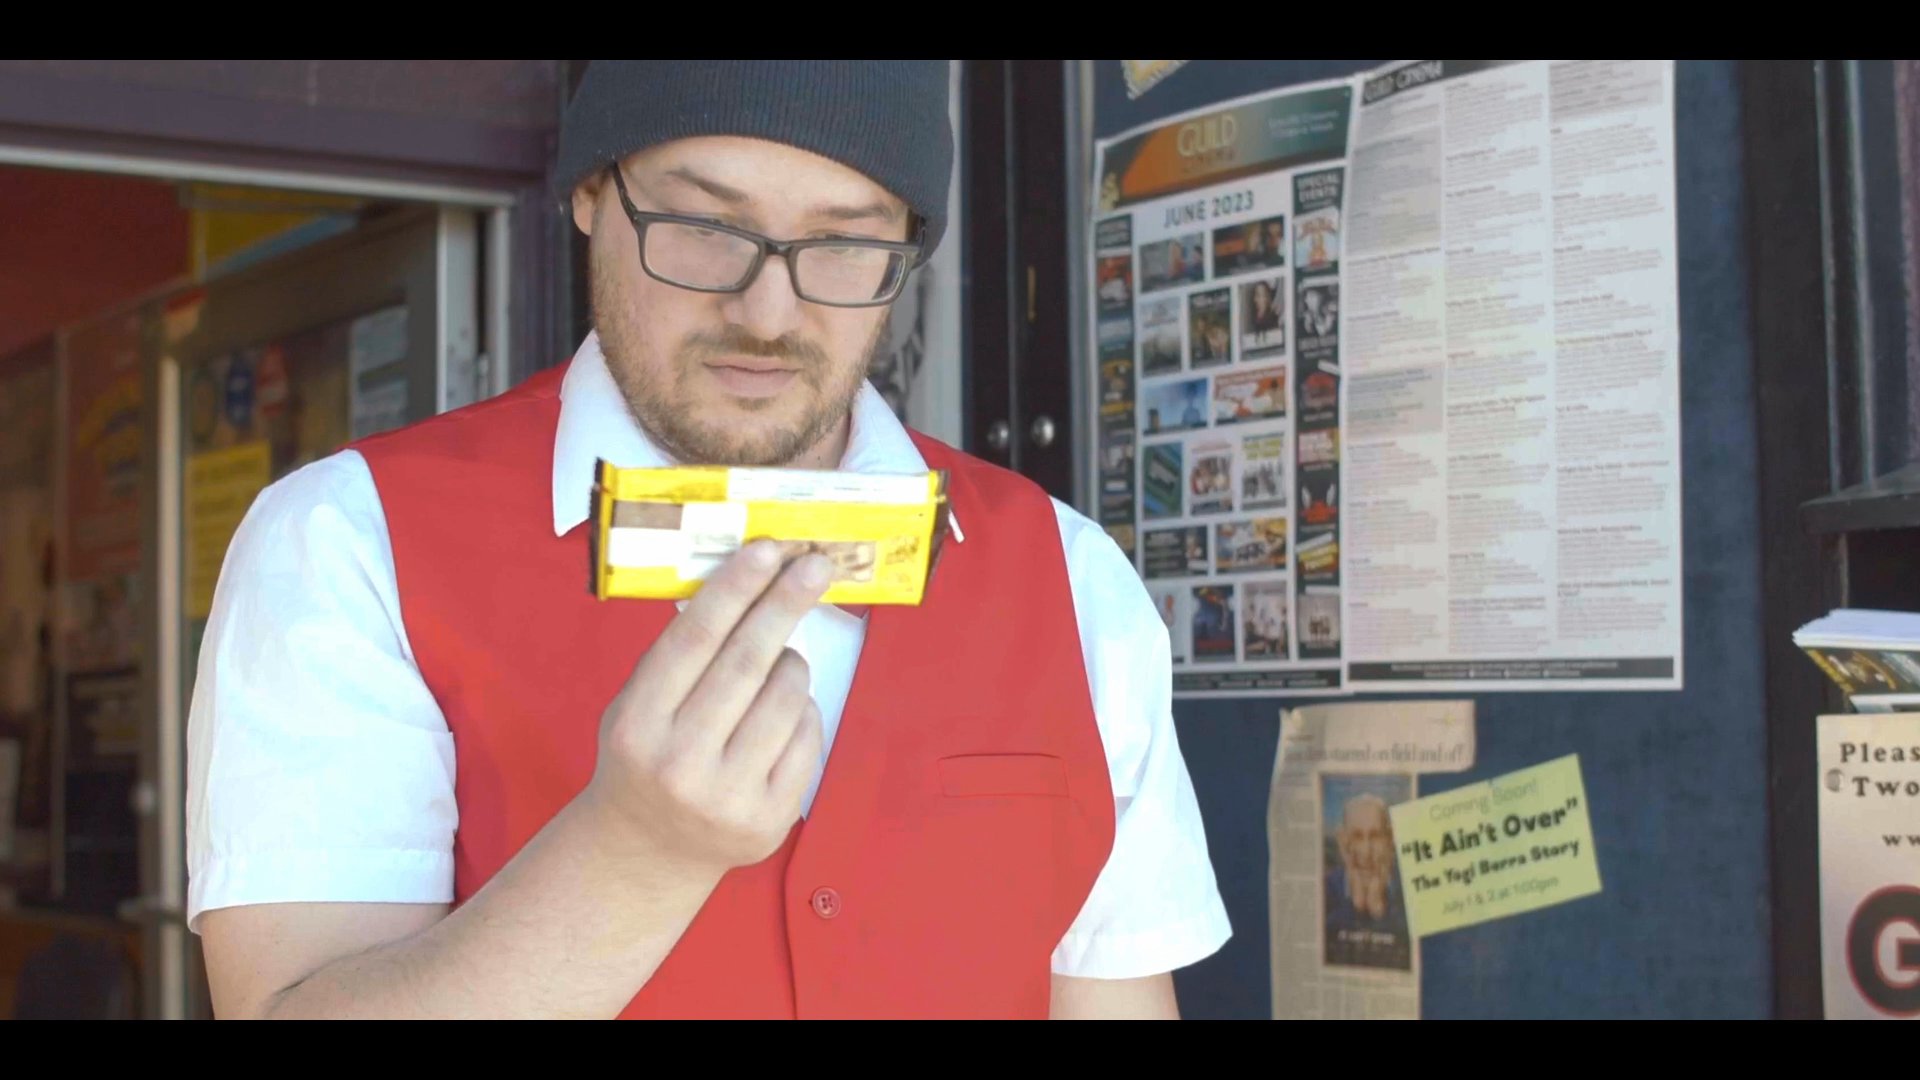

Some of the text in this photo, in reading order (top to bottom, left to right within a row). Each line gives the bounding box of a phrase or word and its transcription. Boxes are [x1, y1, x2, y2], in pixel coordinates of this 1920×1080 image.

[1179, 113, 1237, 156] GUILD
[1164, 189, 1254, 228] JUNE 2023
[1839, 742, 1920, 764] Pleas
[1429, 778, 1537, 821] Coming Soon!
[1852, 776, 1920, 797] Two
[1401, 796, 1578, 863] “It Ain't Over”
[1412, 840, 1579, 892] The Yogi Berra Story
[1442, 898, 1465, 916] July
[1486, 889, 1496, 902] 2
[1845, 884, 1920, 1018] G
